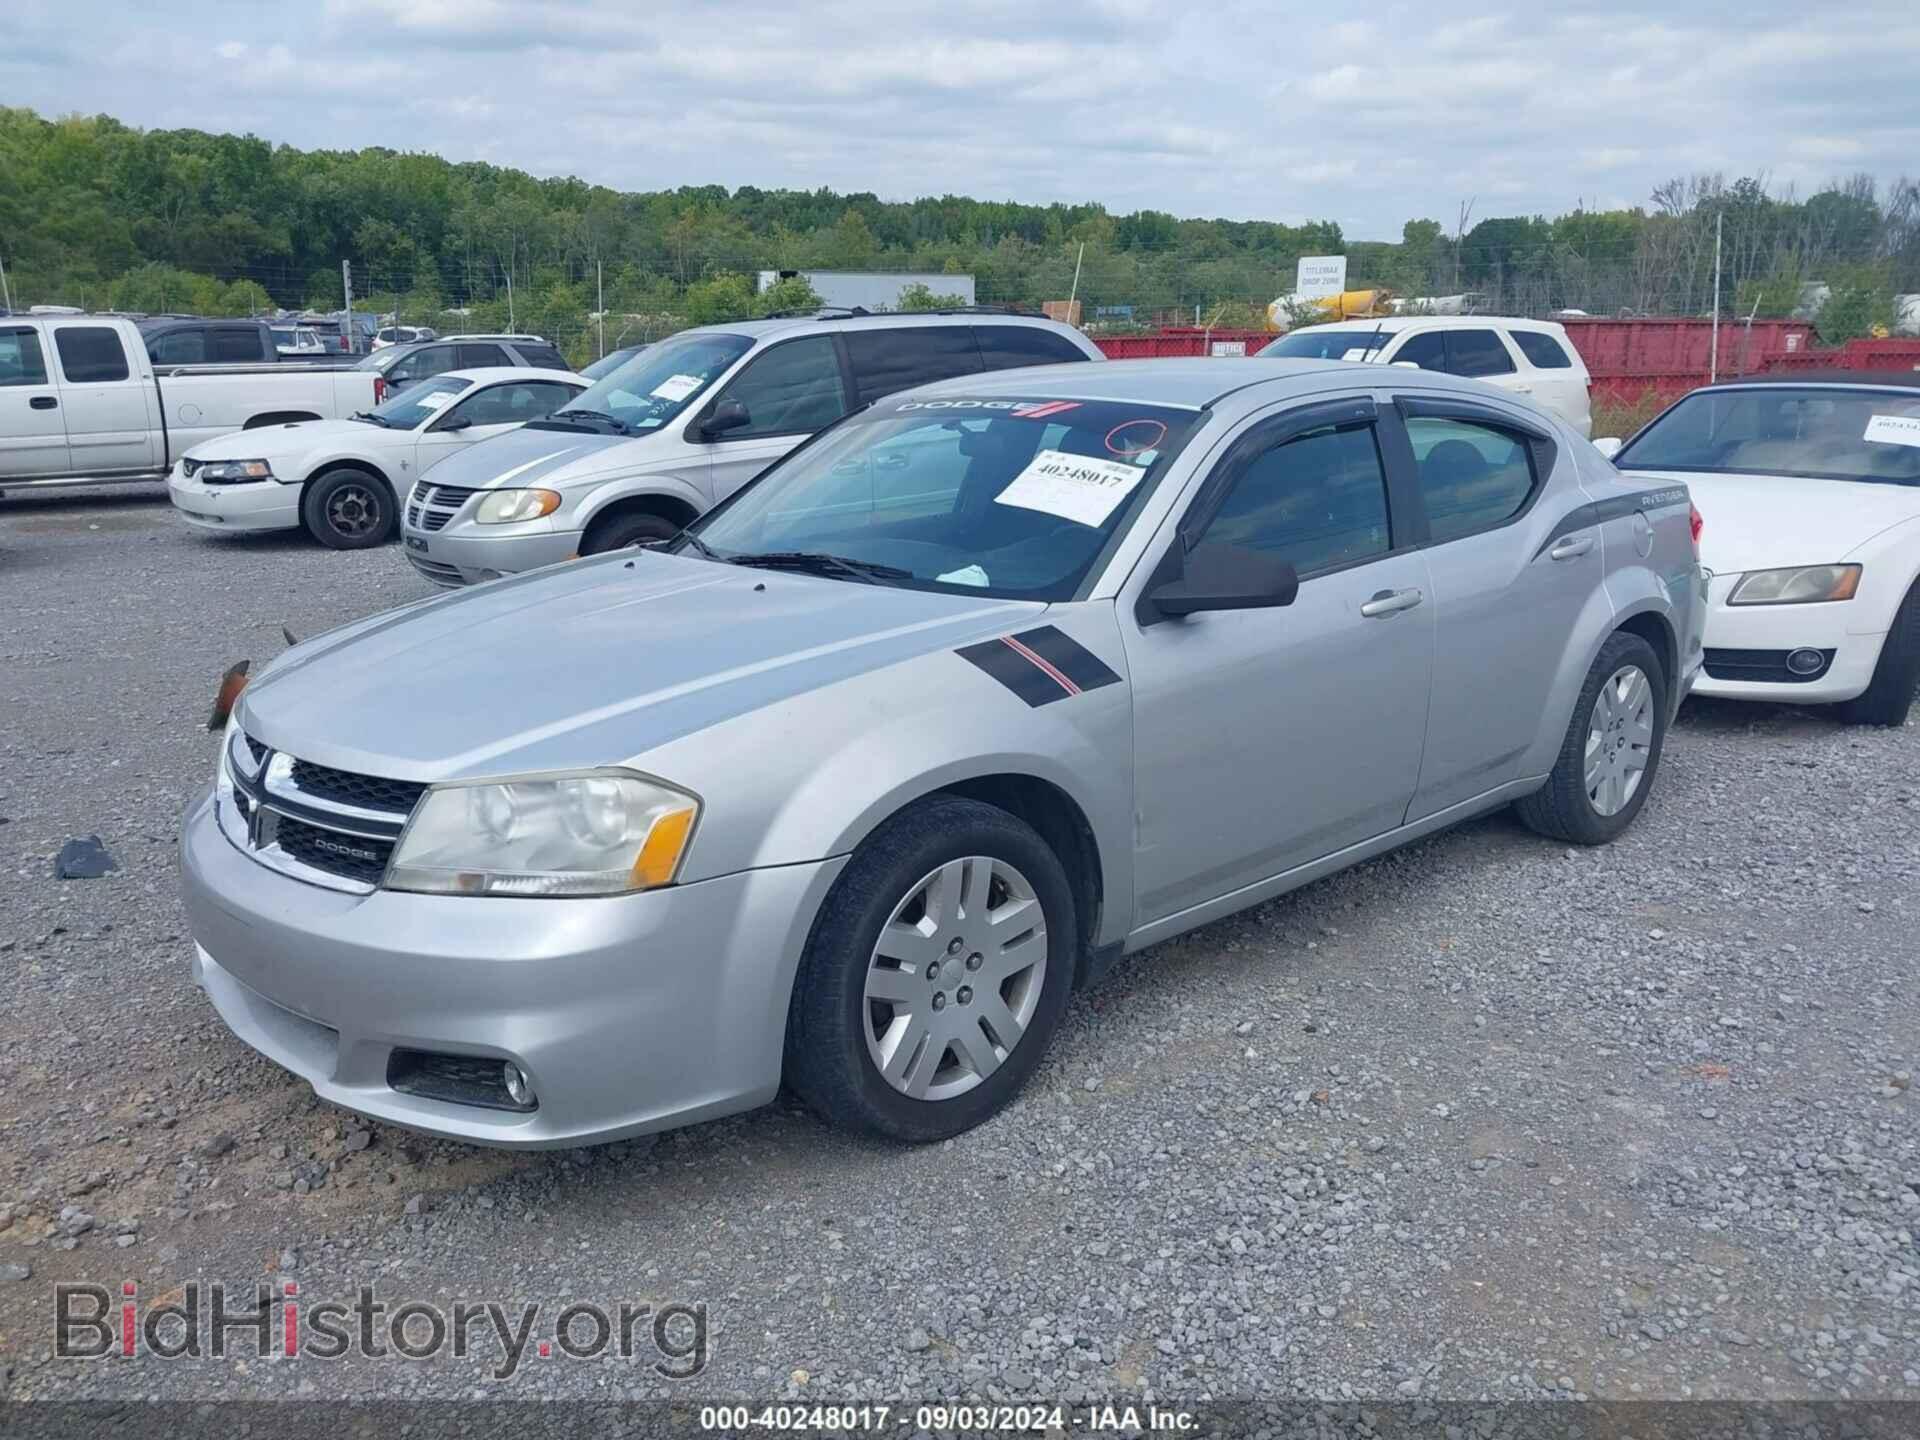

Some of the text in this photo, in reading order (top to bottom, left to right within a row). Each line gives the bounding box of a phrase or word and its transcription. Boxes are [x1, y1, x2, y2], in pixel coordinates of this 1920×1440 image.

[896, 400, 1040, 412] DODGE
[1037, 463, 1122, 488] 40248017
[1641, 489, 1684, 505] AVENGER
[315, 839, 377, 861] DODGE
